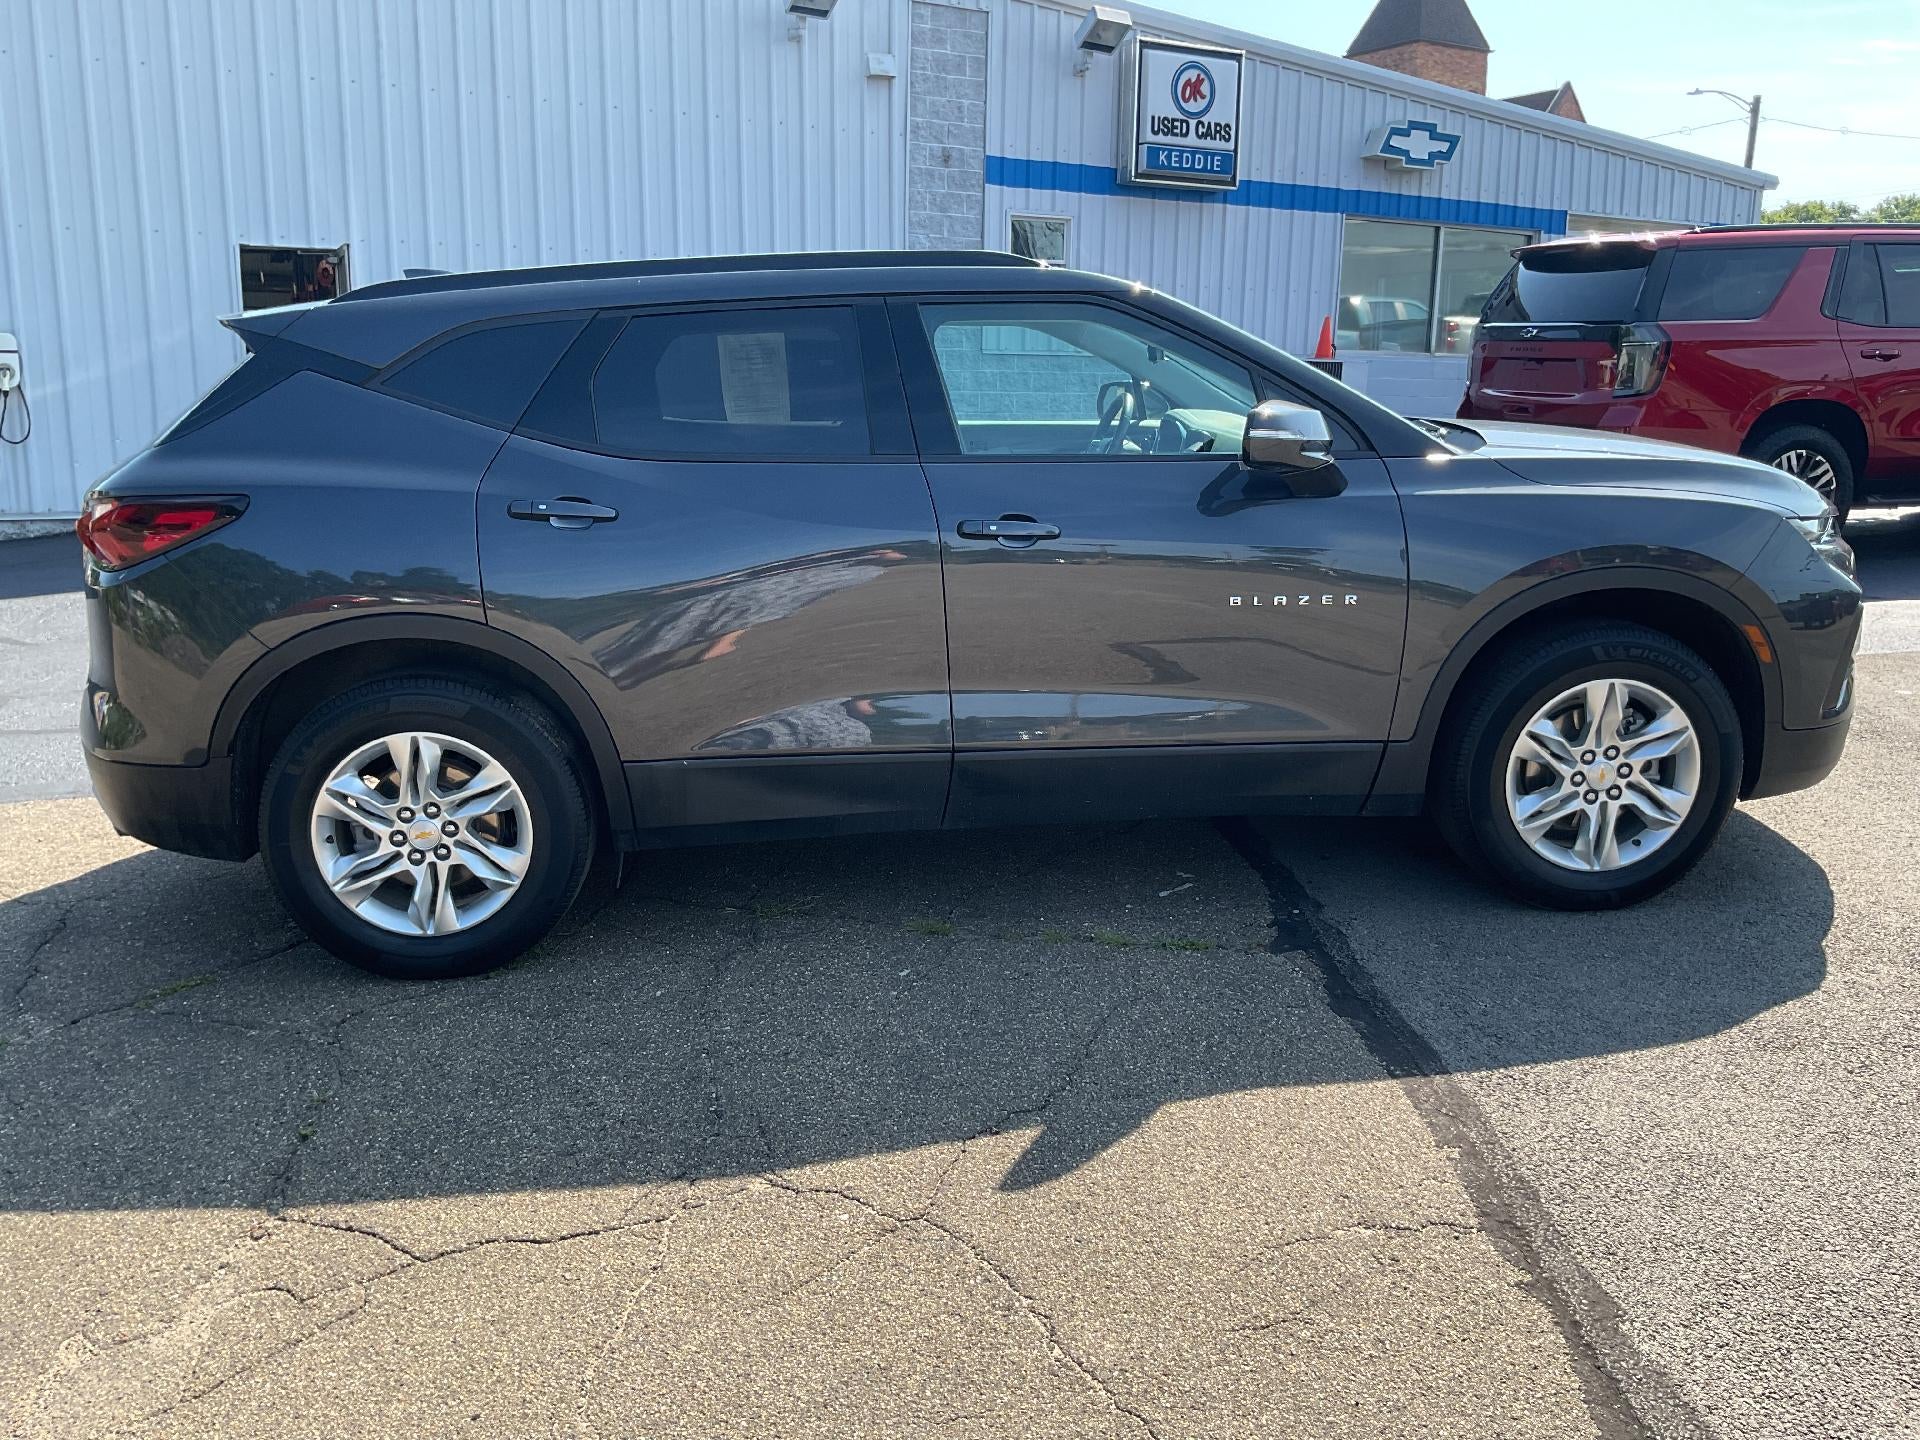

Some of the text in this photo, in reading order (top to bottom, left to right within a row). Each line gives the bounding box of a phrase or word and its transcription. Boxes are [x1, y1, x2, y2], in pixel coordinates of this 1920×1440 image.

[1181, 73, 1206, 103] OK
[1151, 115, 1231, 142] USED CARS
[1159, 150, 1221, 170] KEDDIE
[1229, 594, 1358, 606] BLAZER
